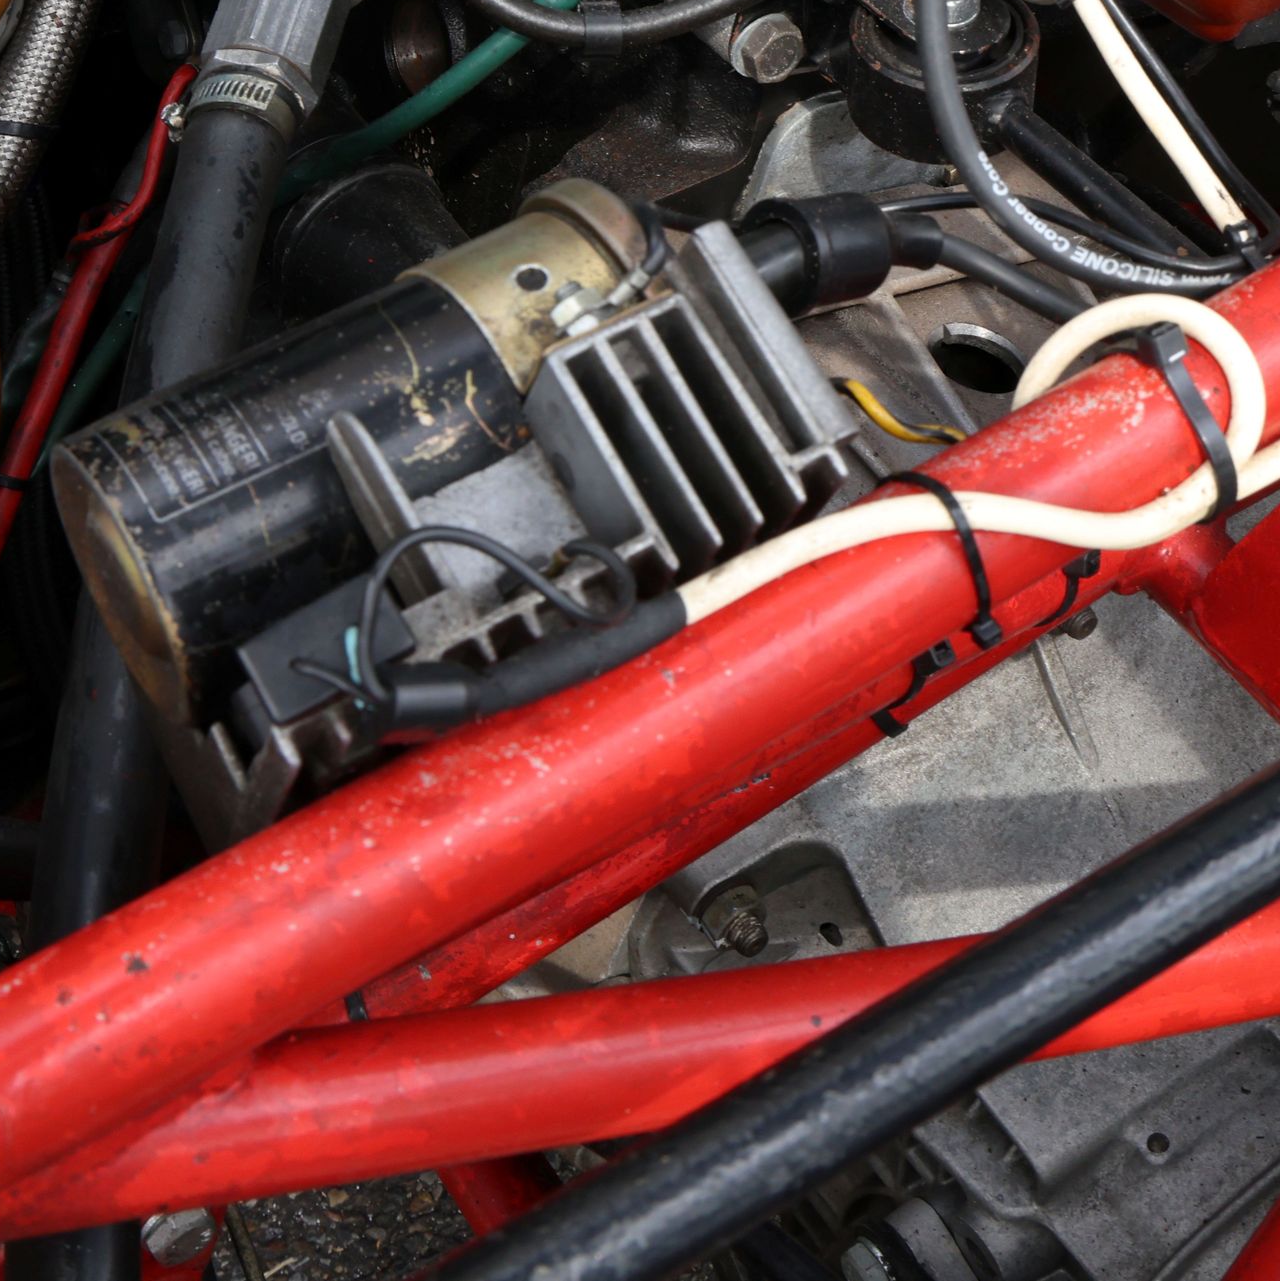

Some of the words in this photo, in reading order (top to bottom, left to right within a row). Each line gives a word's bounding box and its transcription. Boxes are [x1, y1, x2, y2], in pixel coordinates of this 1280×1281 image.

[976, 150, 1009, 197] Core
[1006, 196, 1071, 253] Copper
[1070, 244, 1177, 287] SILICONE
